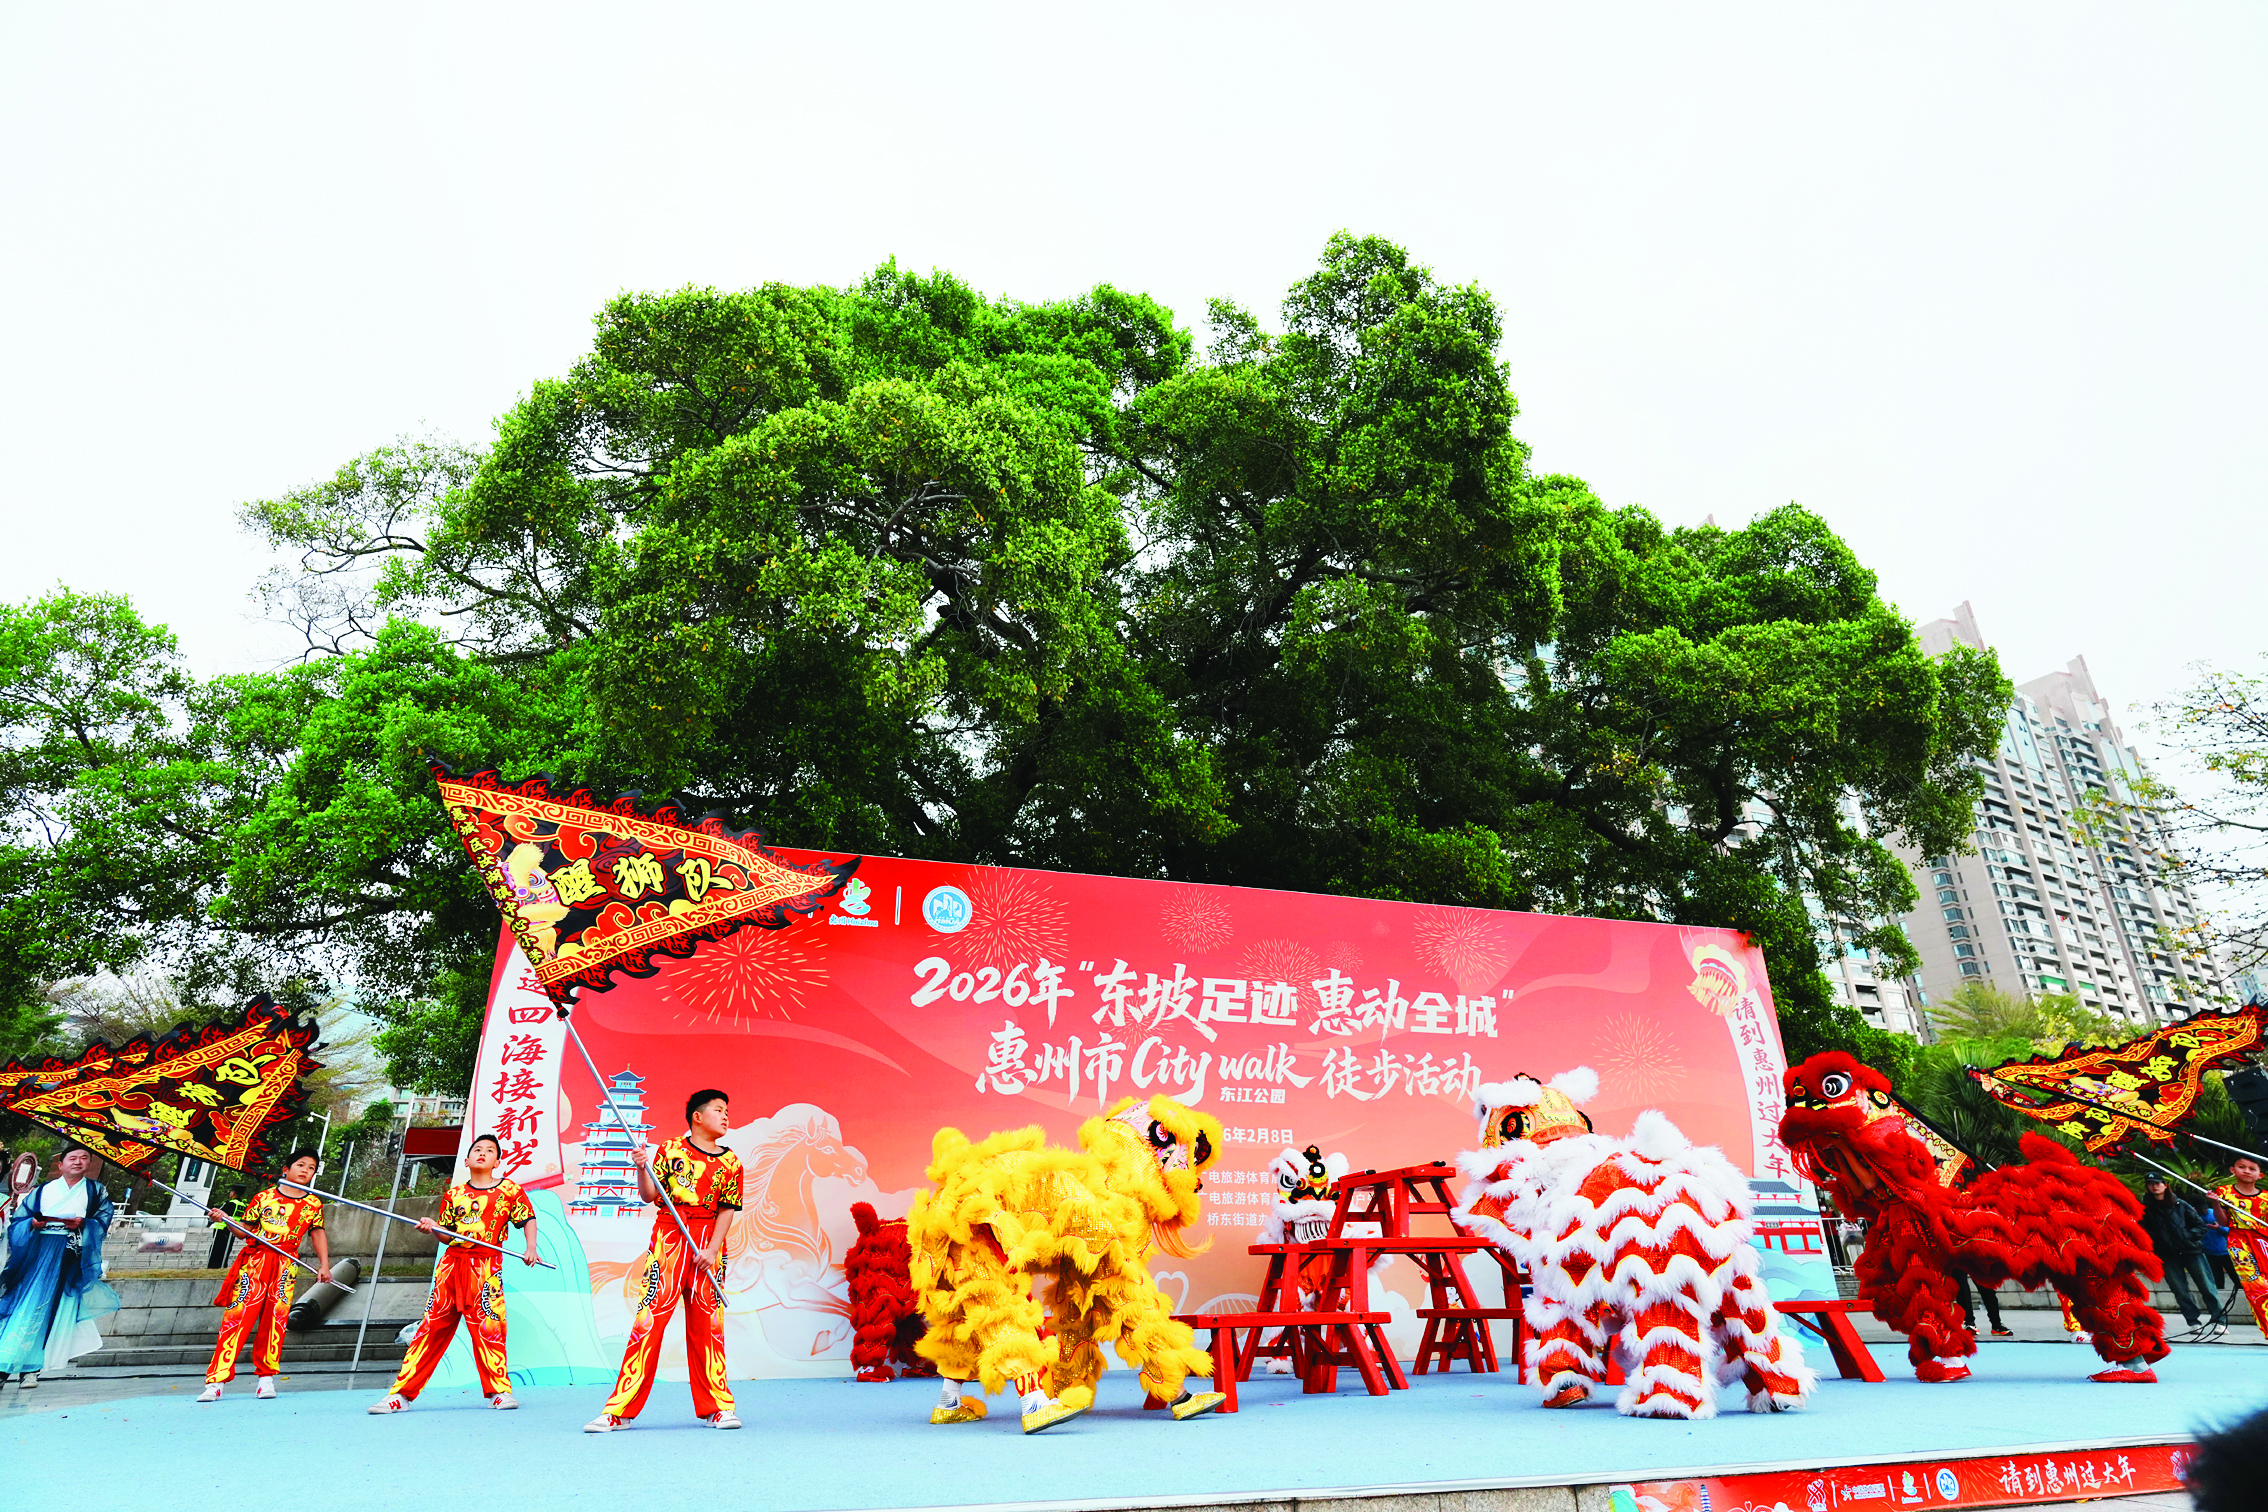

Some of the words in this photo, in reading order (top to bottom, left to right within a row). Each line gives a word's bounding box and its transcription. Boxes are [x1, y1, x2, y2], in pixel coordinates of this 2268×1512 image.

[547, 853, 735, 906] 醒狮队
[1218, 1042, 1317, 1089] walk
[1318, 1046, 1482, 1104] 徒步活动
[1733, 997, 1791, 1179] 请到惠州过大年
[2105, 1033, 2218, 1092] 醒狮队
[1219, 1087, 1286, 1105] 东江公园
[1197, 1191, 1279, 1206] 电旅游体育
[1999, 1454, 2136, 1497] 请到惠州过大年
